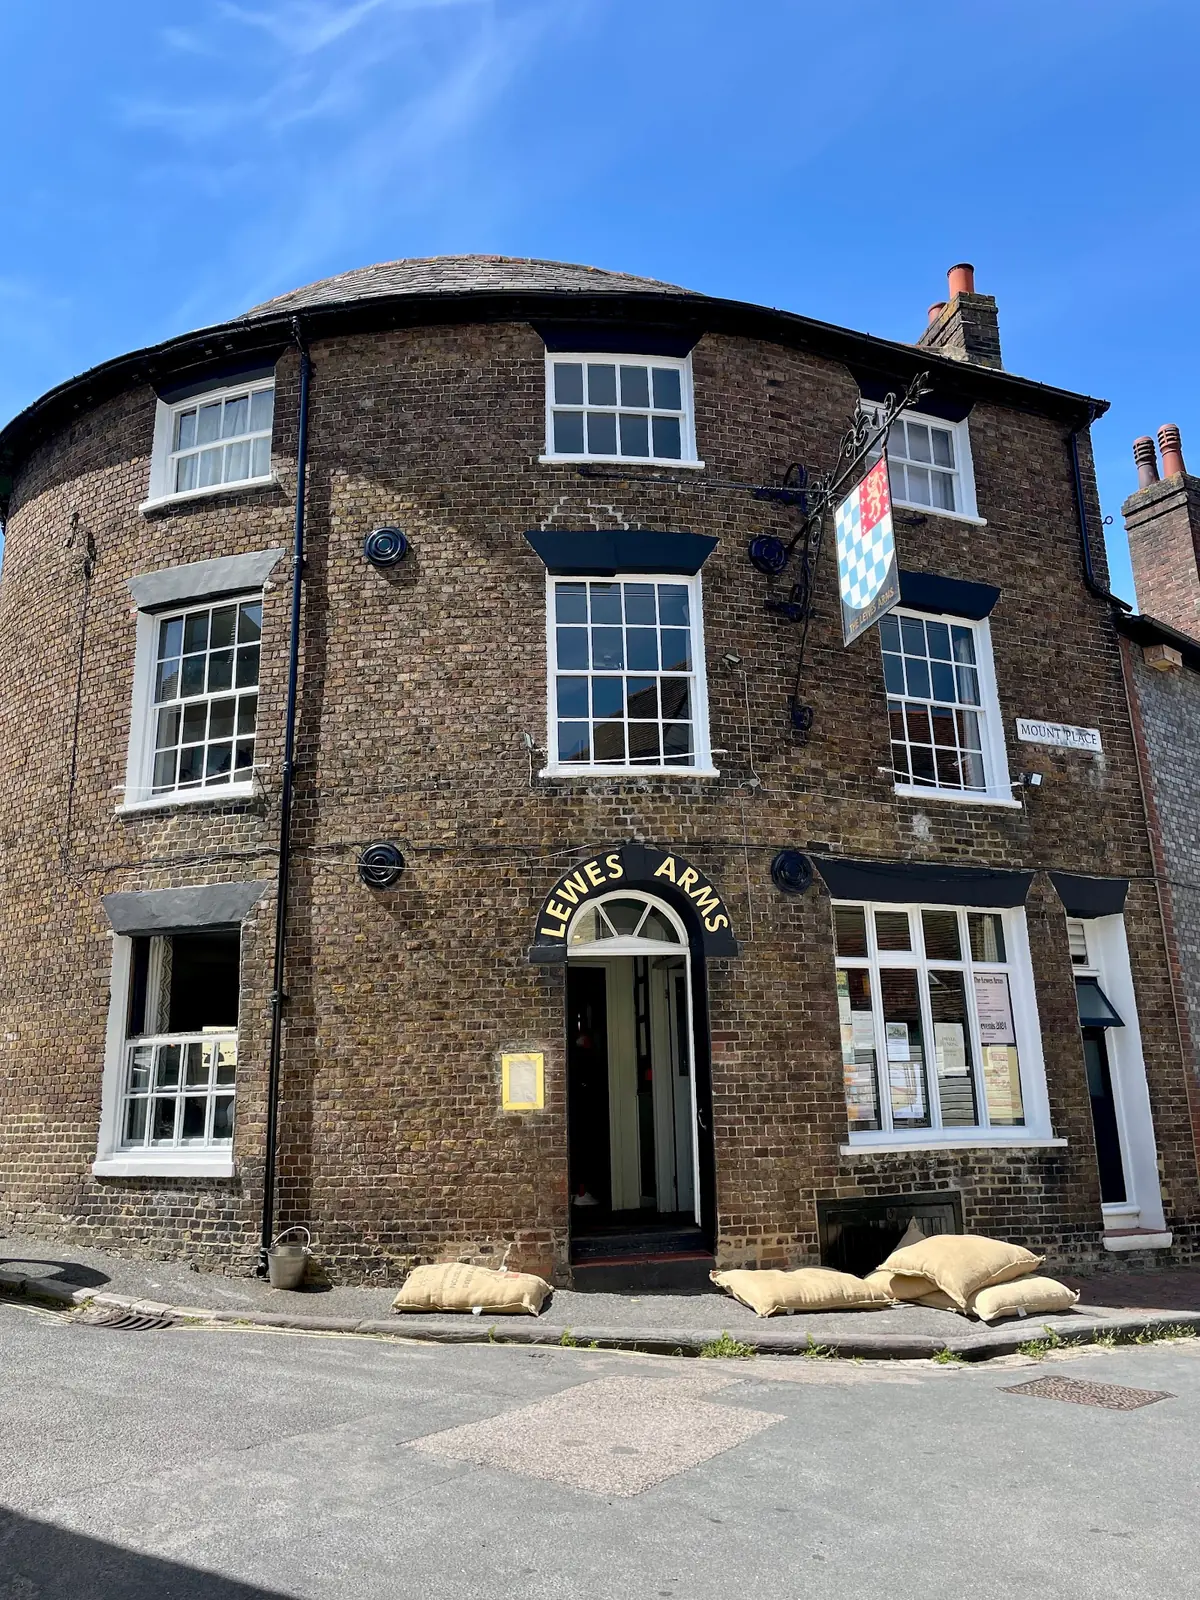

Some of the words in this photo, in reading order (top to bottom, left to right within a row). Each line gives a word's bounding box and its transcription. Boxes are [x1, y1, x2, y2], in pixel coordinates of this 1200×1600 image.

[849, 617, 860, 634] THE
[860, 602, 877, 625] LEWES
[877, 586, 895, 608] ARMS
[1021, 723, 1061, 740] MOUNT
[1066, 729, 1097, 745] PLACE
[540, 854, 624, 939] LEWES
[653, 856, 729, 933] ARMS
